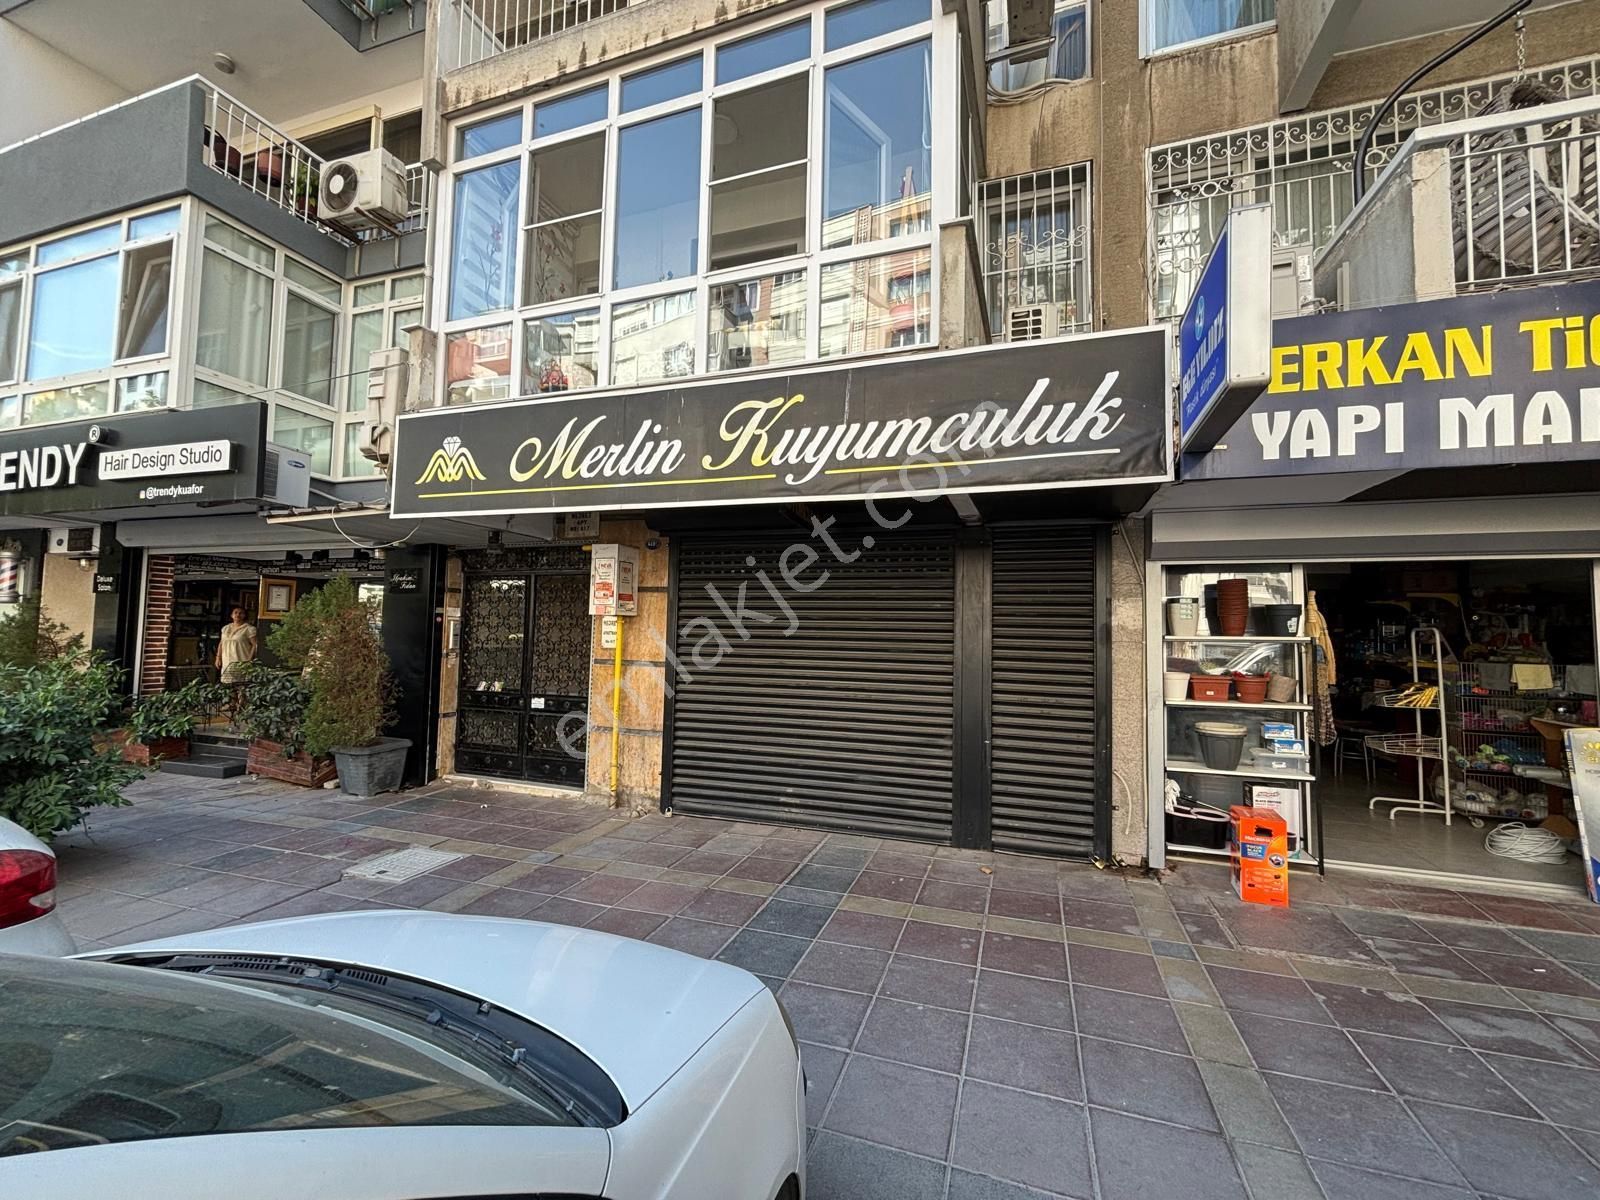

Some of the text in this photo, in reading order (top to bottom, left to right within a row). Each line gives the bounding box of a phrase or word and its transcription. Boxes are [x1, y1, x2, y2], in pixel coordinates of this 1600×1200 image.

[1267, 316, 1600, 394] ERKAN Ti
[509, 371, 1125, 485] Merlin Kuyumculuk
[1252, 402, 1404, 460] YAPI
[104, 445, 223, 472] Hair Design Studio
[146, 484, 204, 499] @trendykuafor
